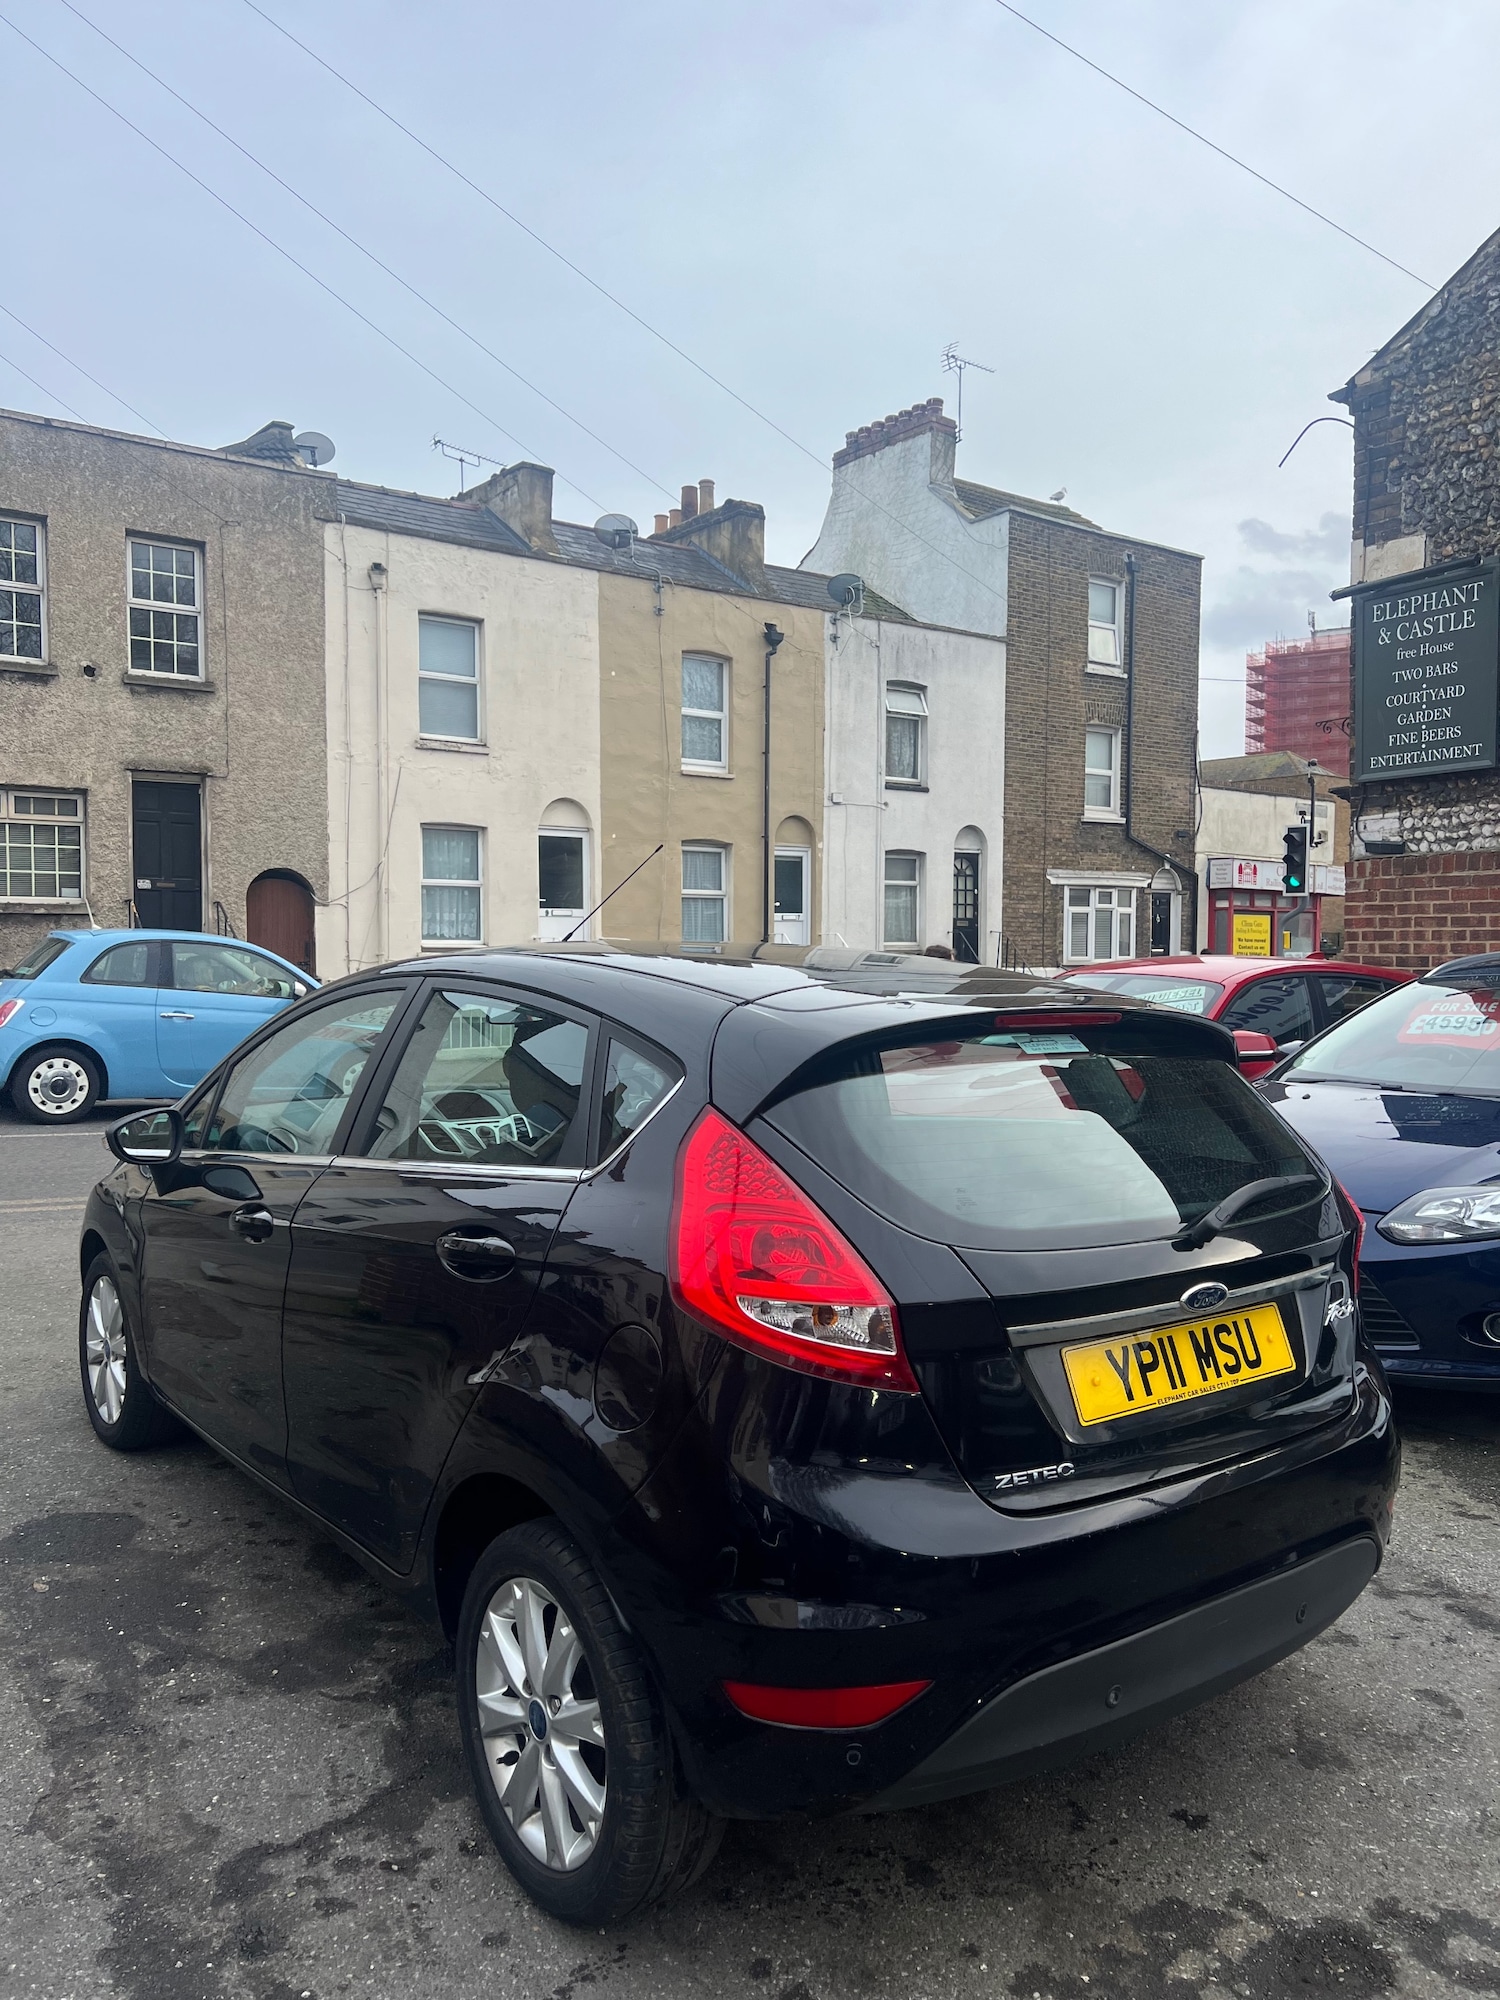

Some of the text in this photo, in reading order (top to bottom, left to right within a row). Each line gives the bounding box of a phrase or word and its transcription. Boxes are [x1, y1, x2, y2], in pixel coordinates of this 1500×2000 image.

[1372, 581, 1484, 623] ELEPHANT
[1378, 608, 1476, 646] & CASTLE
[1420, 641, 1455, 657] House
[1392, 661, 1458, 683] TWO BARS
[1385, 684, 1465, 708] COURTYARD
[1397, 707, 1452, 726] GARDEN
[1389, 725, 1462, 746] FINE BEERS
[1370, 743, 1483, 769] ENTERTAINMENT
[1430, 1002, 1499, 1013] FOR SALE
[1105, 1317, 1262, 1402] YP11 MSU
[1157, 1392, 1186, 1405] ELEPHANT
[1187, 1389, 1200, 1397] CAR
[1199, 1385, 1217, 1394] SALES
[994, 1462, 1075, 1489] ZETEC
